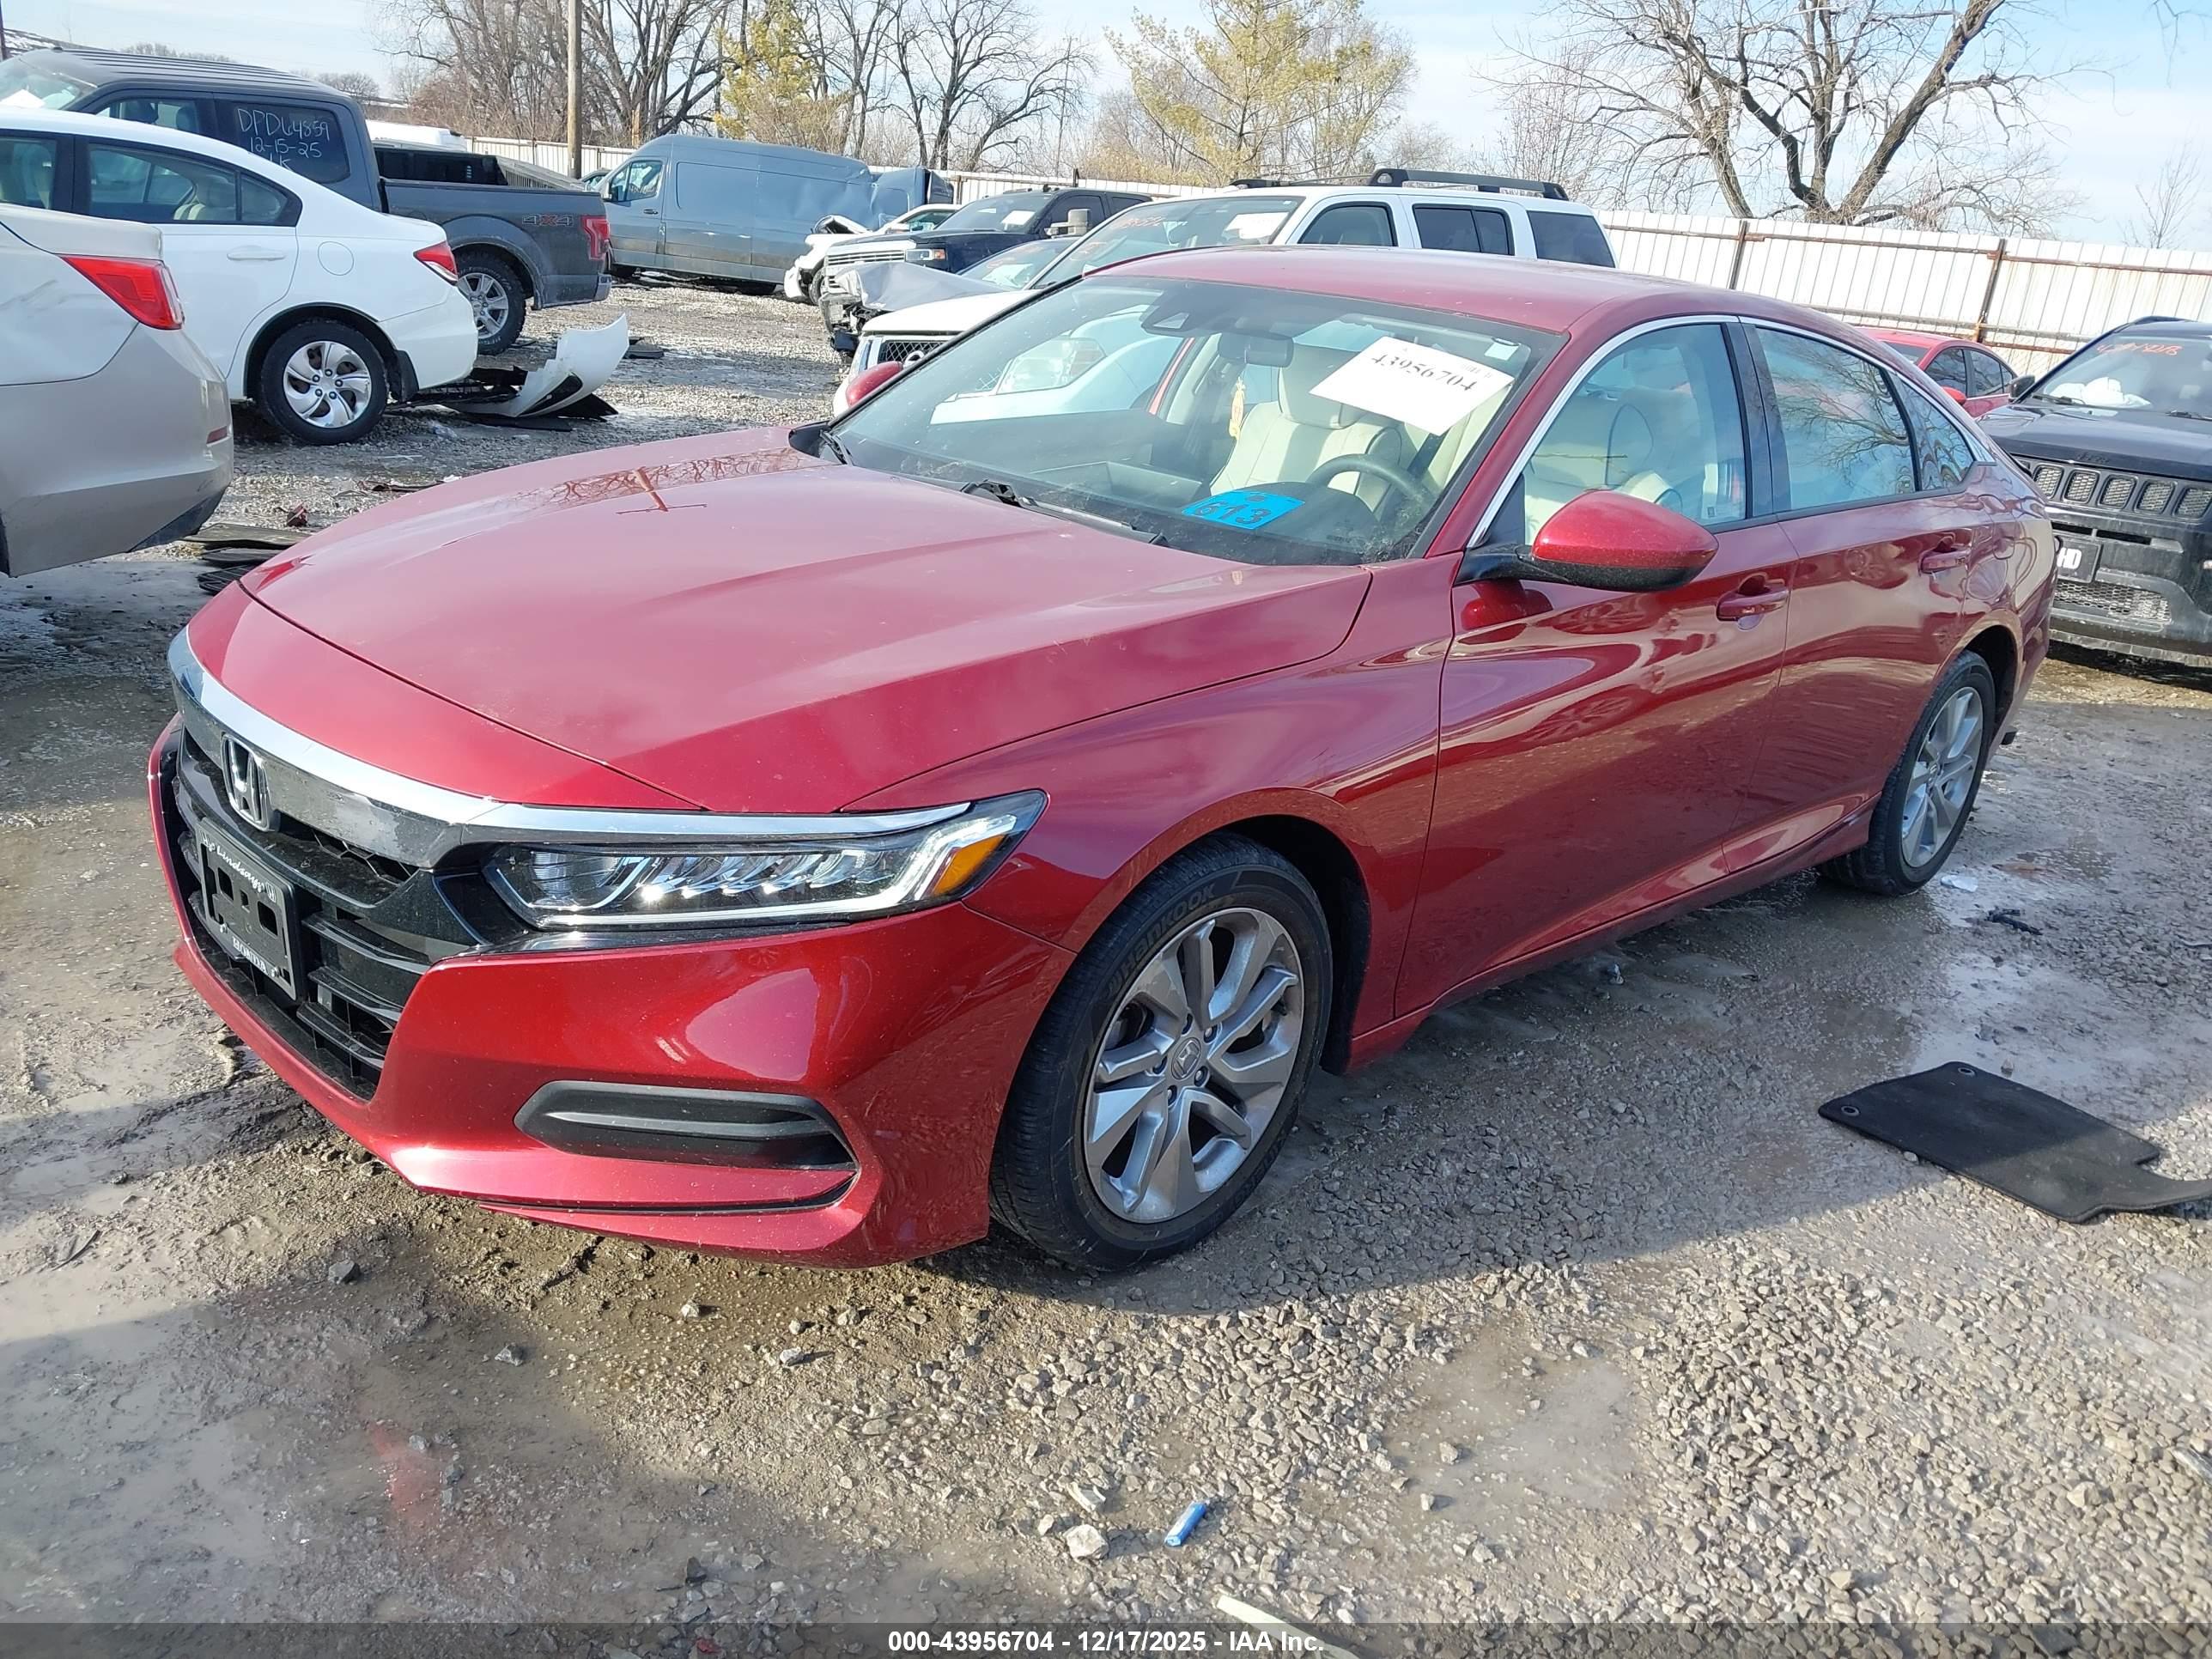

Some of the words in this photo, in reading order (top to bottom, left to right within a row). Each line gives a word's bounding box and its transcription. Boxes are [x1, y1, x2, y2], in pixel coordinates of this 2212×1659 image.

[237, 108, 331, 141] DPD64859
[250, 137, 322, 158] 12-15-25
[1371, 355, 1477, 391] 43956704
[1194, 501, 1271, 524] 613
[232, 935, 270, 976] HONDA
